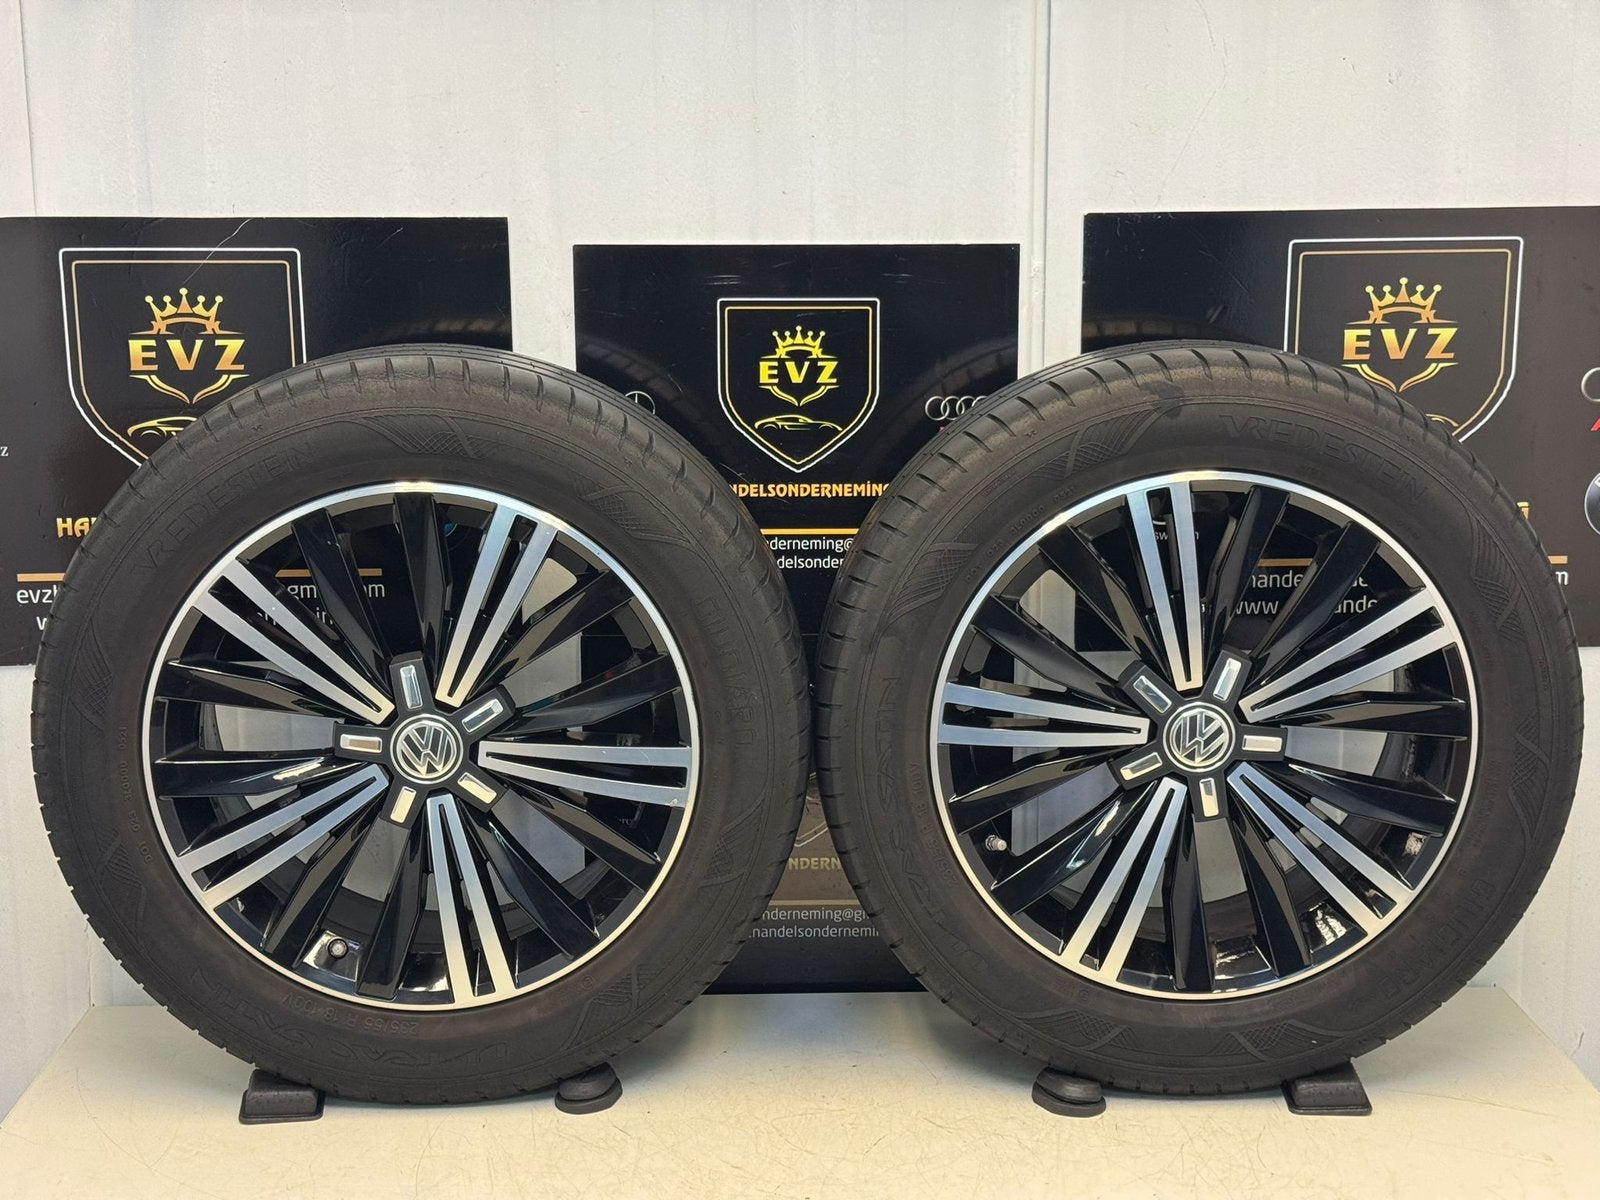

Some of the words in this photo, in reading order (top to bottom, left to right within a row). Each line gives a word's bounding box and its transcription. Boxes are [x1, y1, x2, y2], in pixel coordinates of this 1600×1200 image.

[128, 339, 246, 372] EVZ
[1343, 328, 1458, 361] EVZ
[759, 361, 838, 384] EVZ
